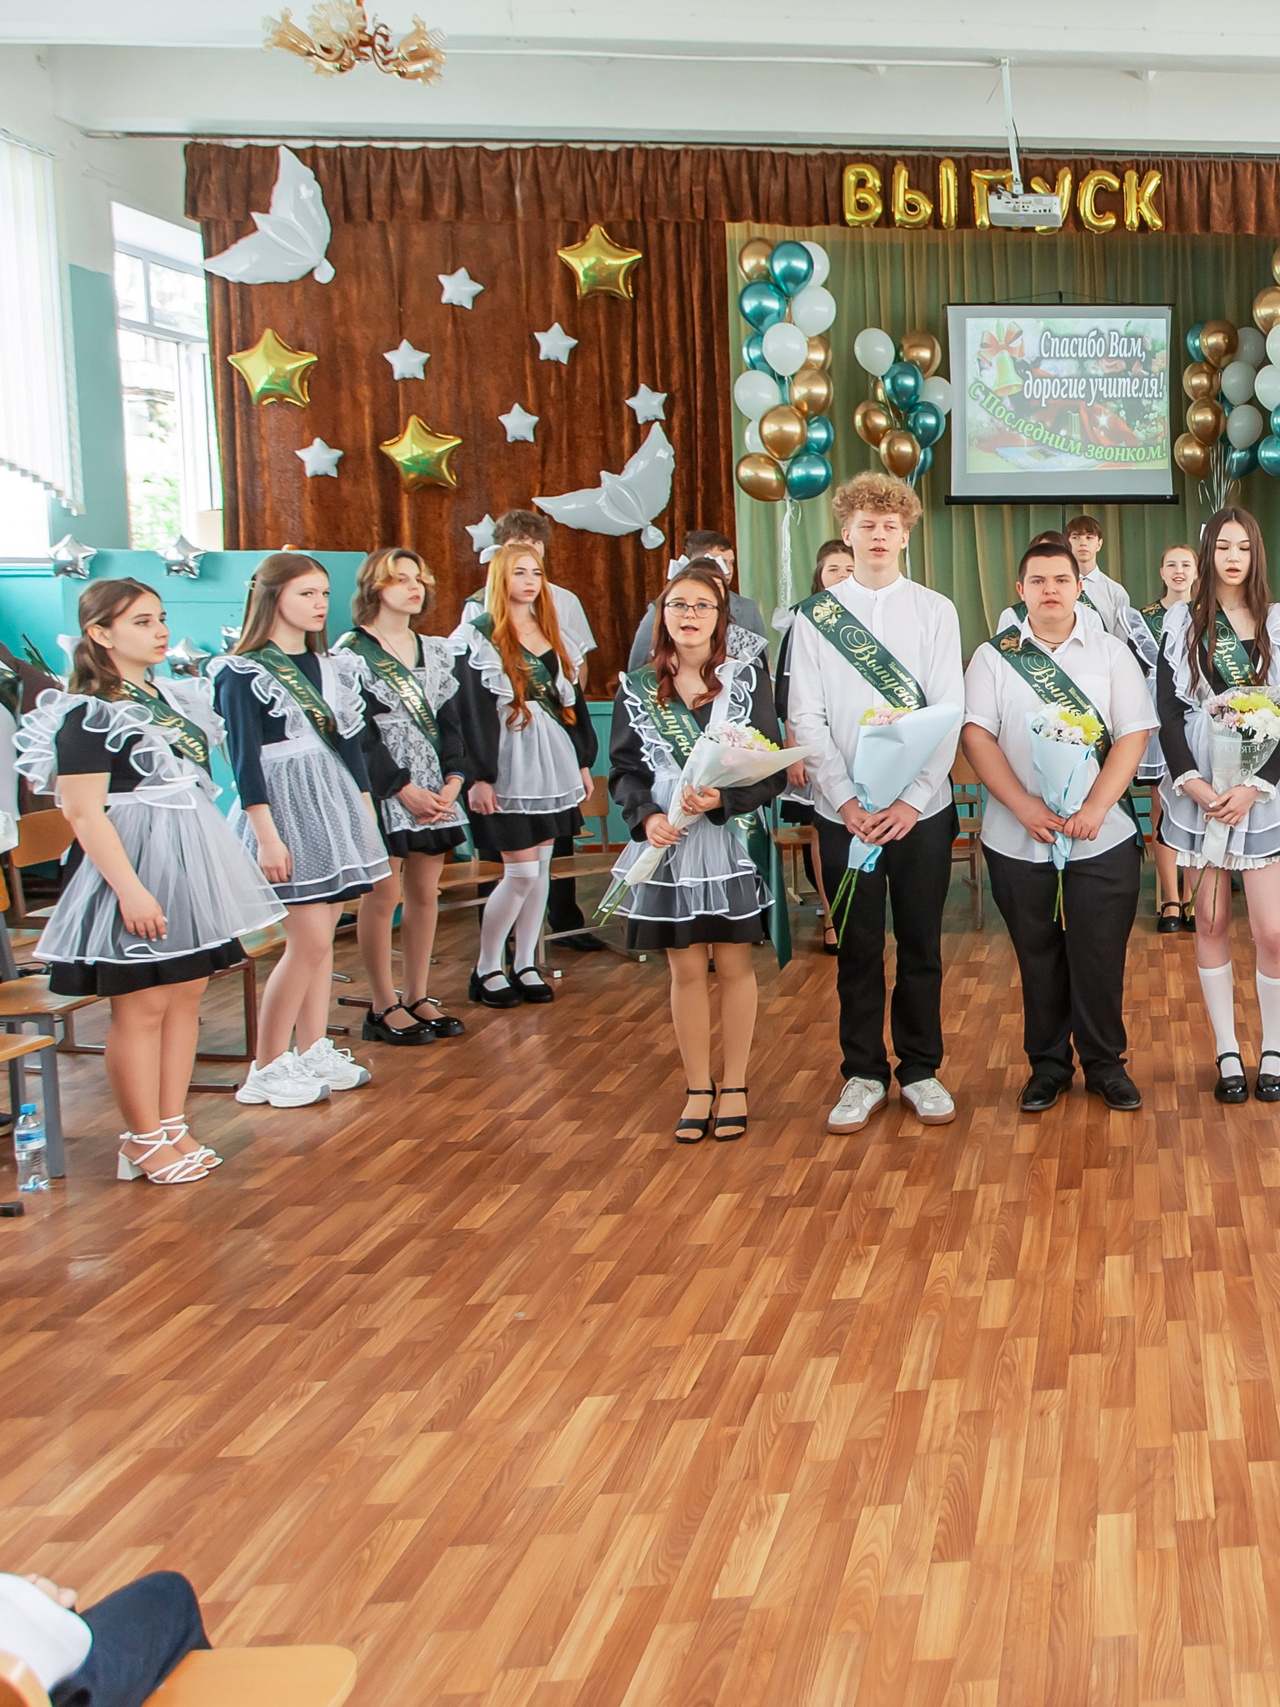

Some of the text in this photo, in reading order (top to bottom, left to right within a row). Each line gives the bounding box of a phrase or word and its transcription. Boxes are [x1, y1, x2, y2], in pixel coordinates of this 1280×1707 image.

[1040, 328, 1146, 362] Спасибо Вам,
[1023, 370, 1164, 407] дорогие учителя!
[980, 391, 1082, 457] Последним
[1085, 439, 1167, 462] звонком!
[839, 624, 920, 710] Выпускн
